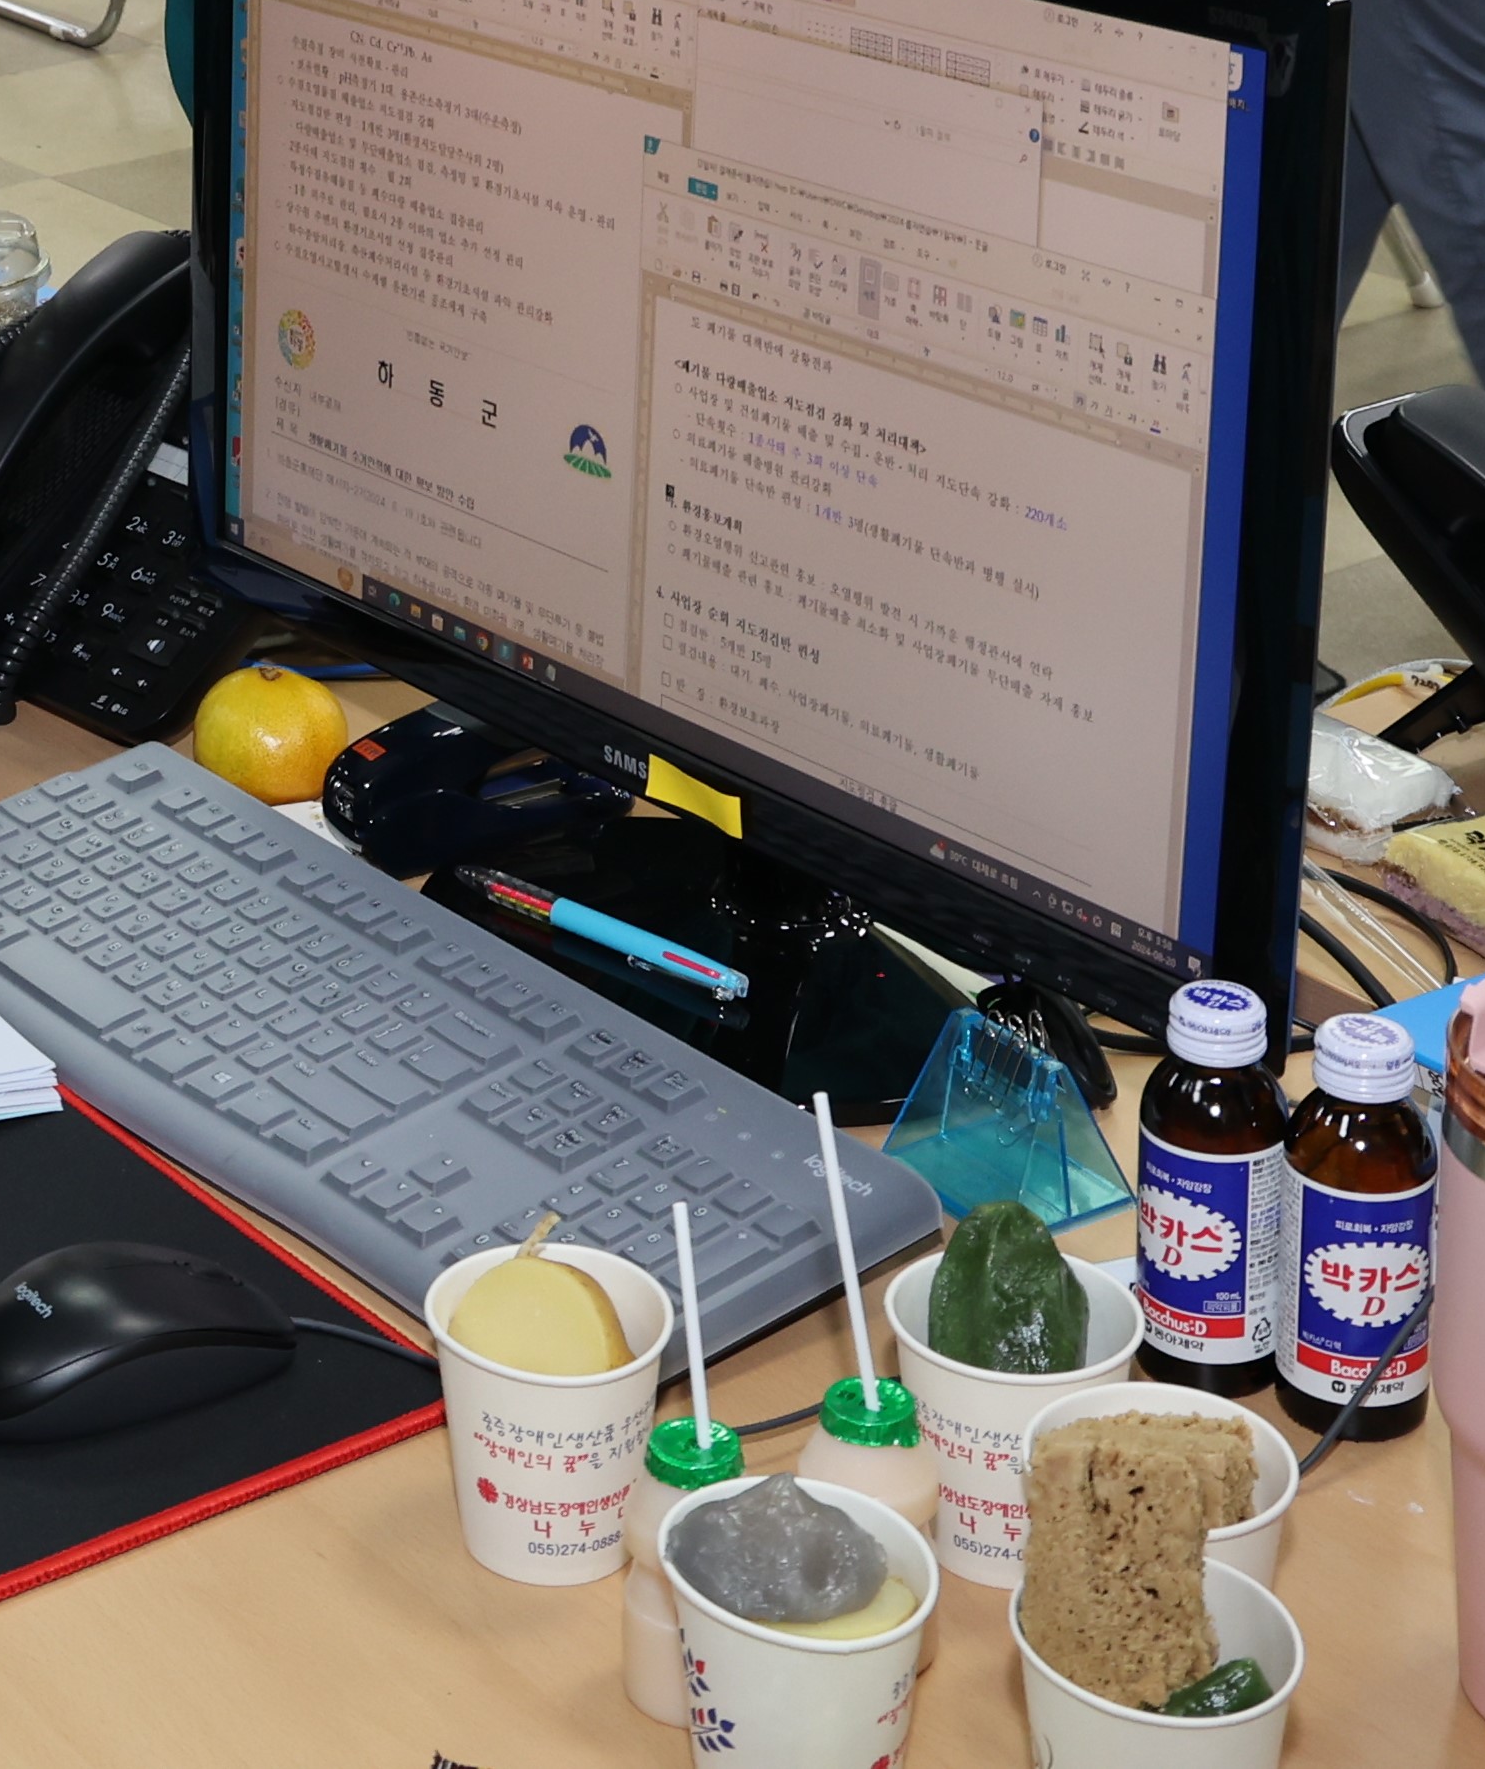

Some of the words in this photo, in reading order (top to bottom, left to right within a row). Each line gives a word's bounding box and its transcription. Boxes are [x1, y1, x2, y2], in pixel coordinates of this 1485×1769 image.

[378, 360, 394, 388] 하
[429, 380, 444, 408] 동
[481, 399, 497, 428] 군
[603, 744, 647, 779] SAMS
[1146, 1160, 1170, 1182] 피로회복
[1177, 1178, 1213, 1194] 자양강장
[1140, 1198, 1223, 1253] 박카스
[1335, 1220, 1372, 1234] 피로회복
[1380, 1220, 1414, 1233] 자양강장
[1162, 1245, 1182, 1266] D
[1321, 1258, 1420, 1294] 박카스
[1361, 1297, 1386, 1316] D
[1154, 1327, 1204, 1351] 동아제약
[482, 1411, 616, 1449] 중증장애인생산품
[915, 1398, 1022, 1450] 증장애인생산
[938, 1483, 1031, 1519] 상남도장애인
[534, 1520, 553, 1538] 나
[579, 1520, 596, 1537] 누
[959, 1512, 976, 1534] 나
[1003, 1523, 1022, 1541] 누
